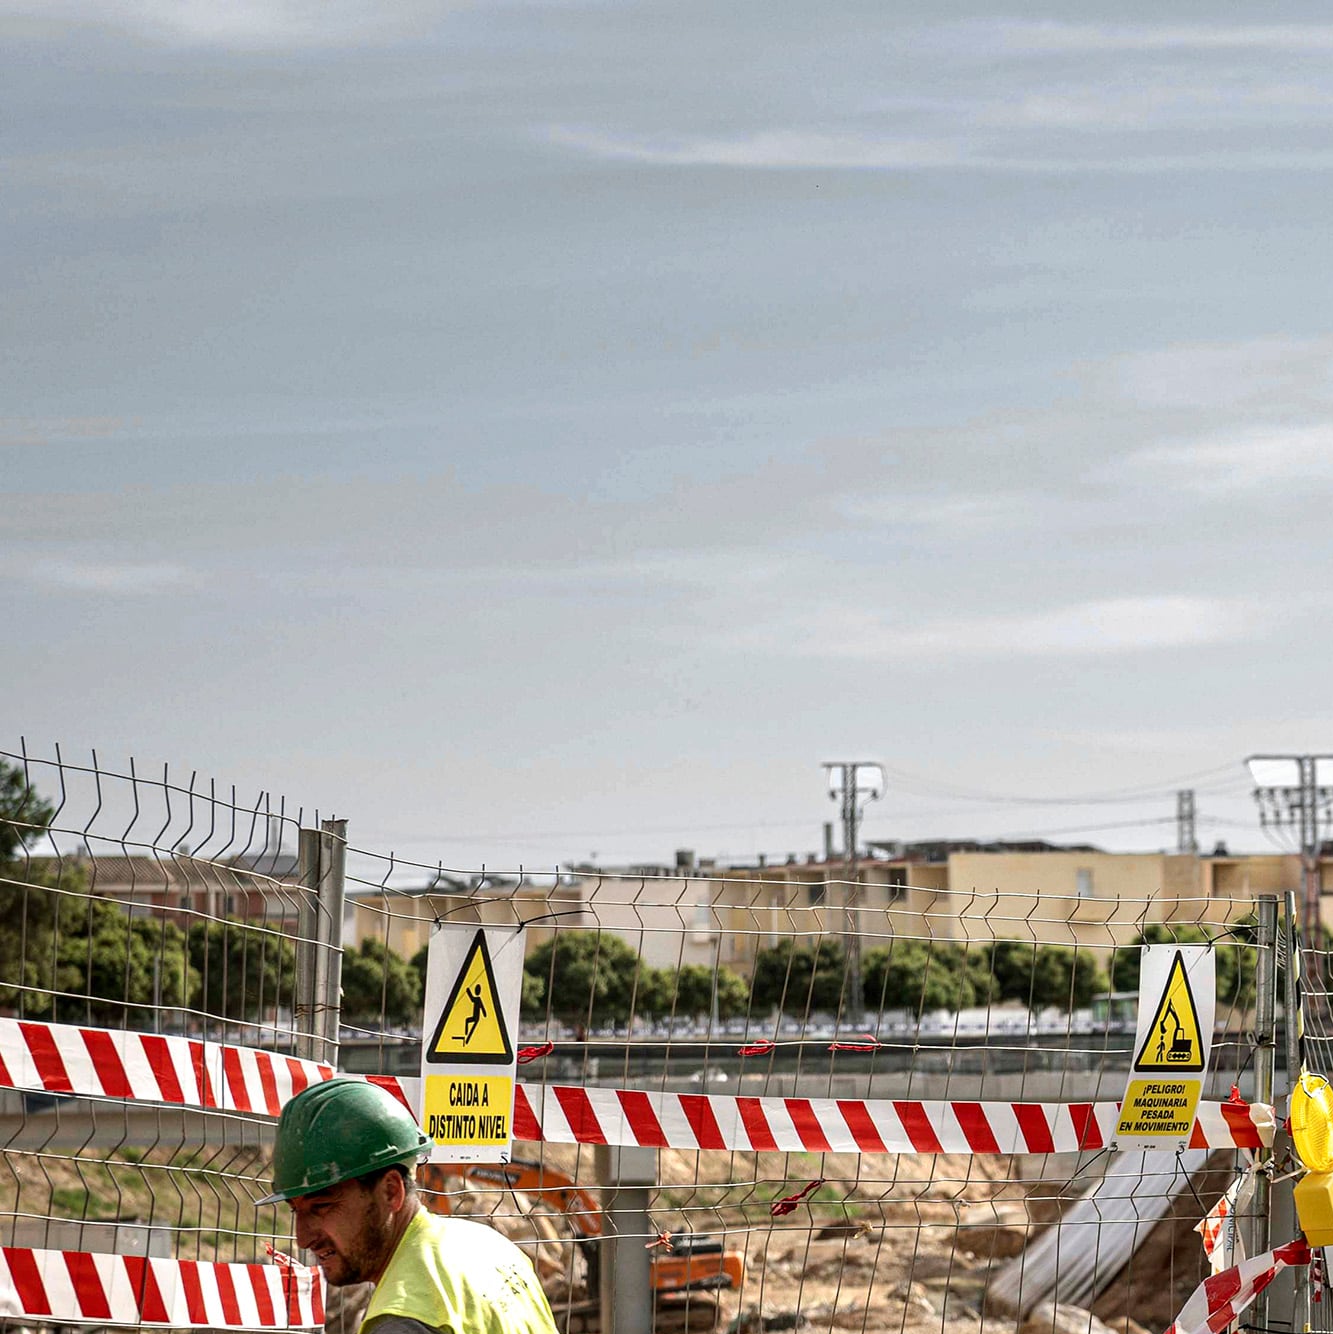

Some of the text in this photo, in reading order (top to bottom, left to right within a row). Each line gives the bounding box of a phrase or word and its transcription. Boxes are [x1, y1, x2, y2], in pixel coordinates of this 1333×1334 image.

[449, 1082, 489, 1107] CAIDA A
[1143, 1084, 1186, 1096] ¡PELIGRO!
[1133, 1097, 1188, 1108] MAQUINARIA
[1140, 1109, 1174, 1120] PESADA
[429, 1114, 507, 1140] DISTINTO NIVEL
[1119, 1121, 1190, 1132] EN MOVIMIENTO
